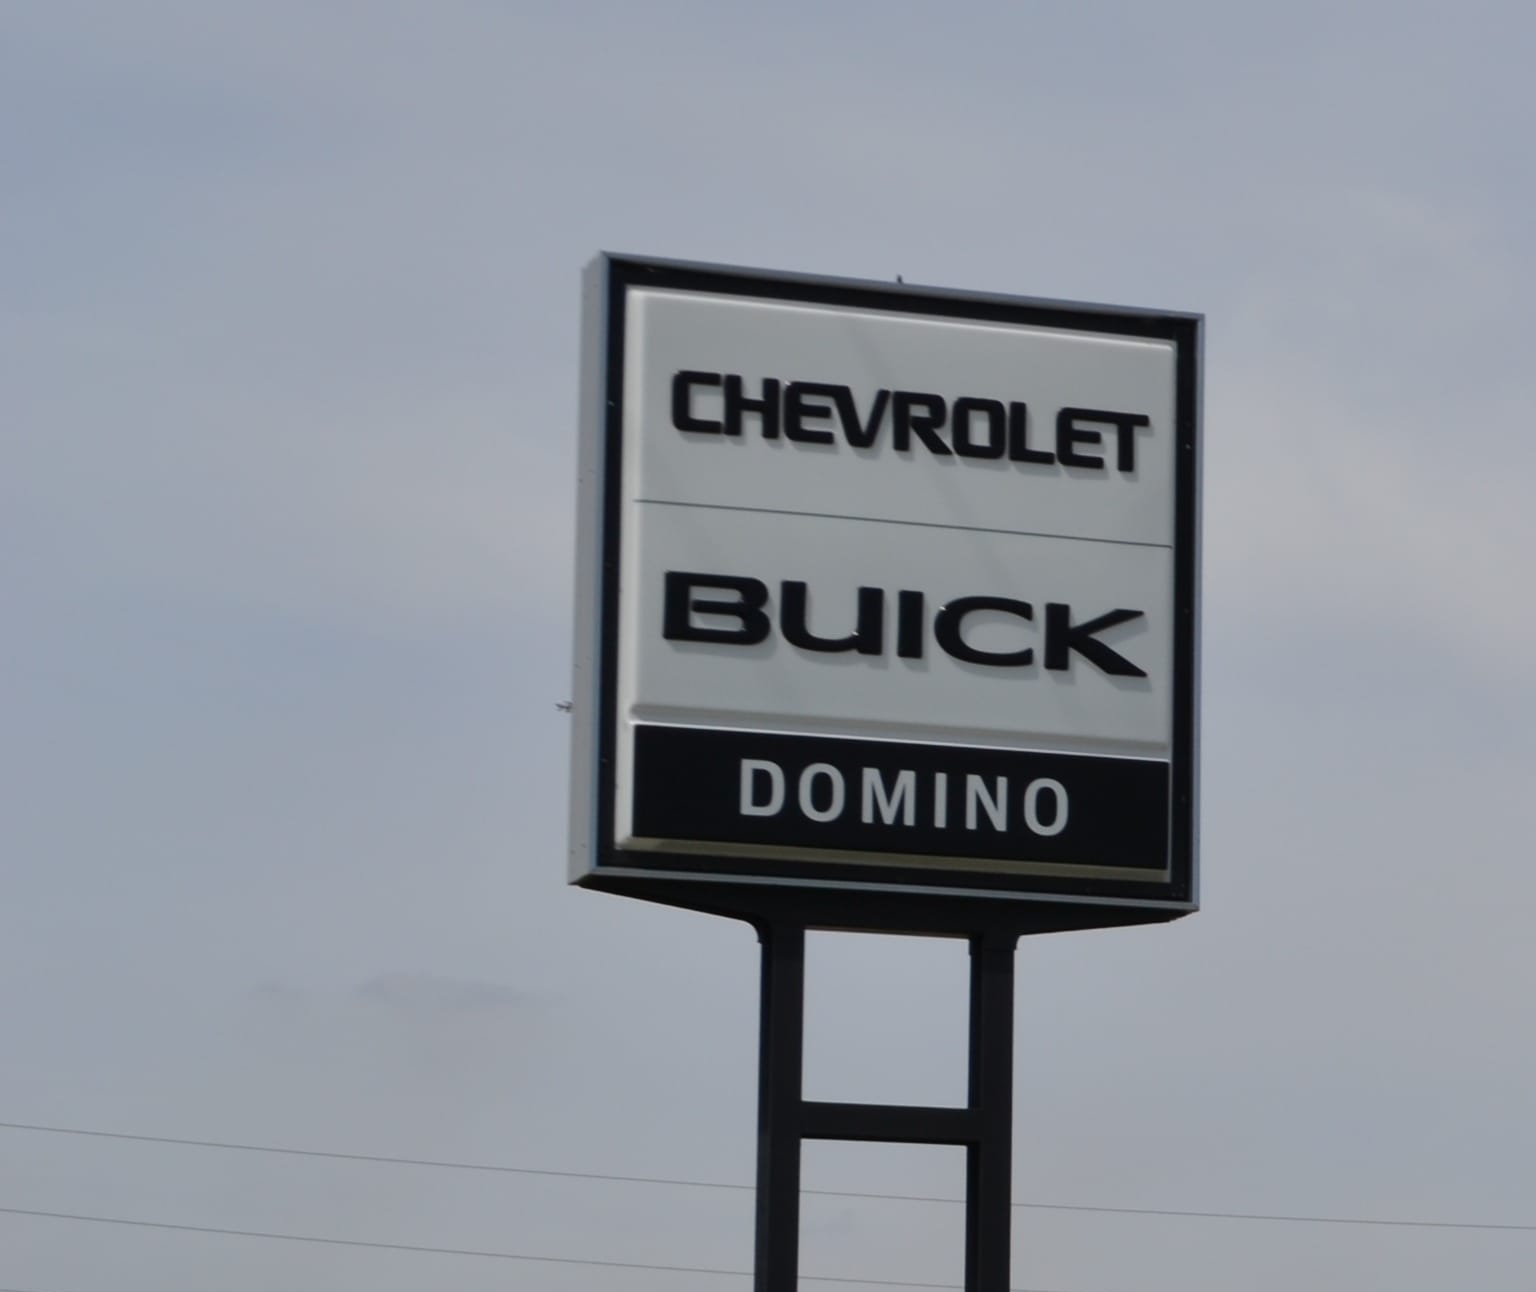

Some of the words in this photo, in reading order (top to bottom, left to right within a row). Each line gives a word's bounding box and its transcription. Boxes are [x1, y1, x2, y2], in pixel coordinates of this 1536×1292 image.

[670, 370, 1149, 473] CHEVROLET
[663, 570, 1147, 678] BUICK
[739, 758, 1069, 836] DOMINO
